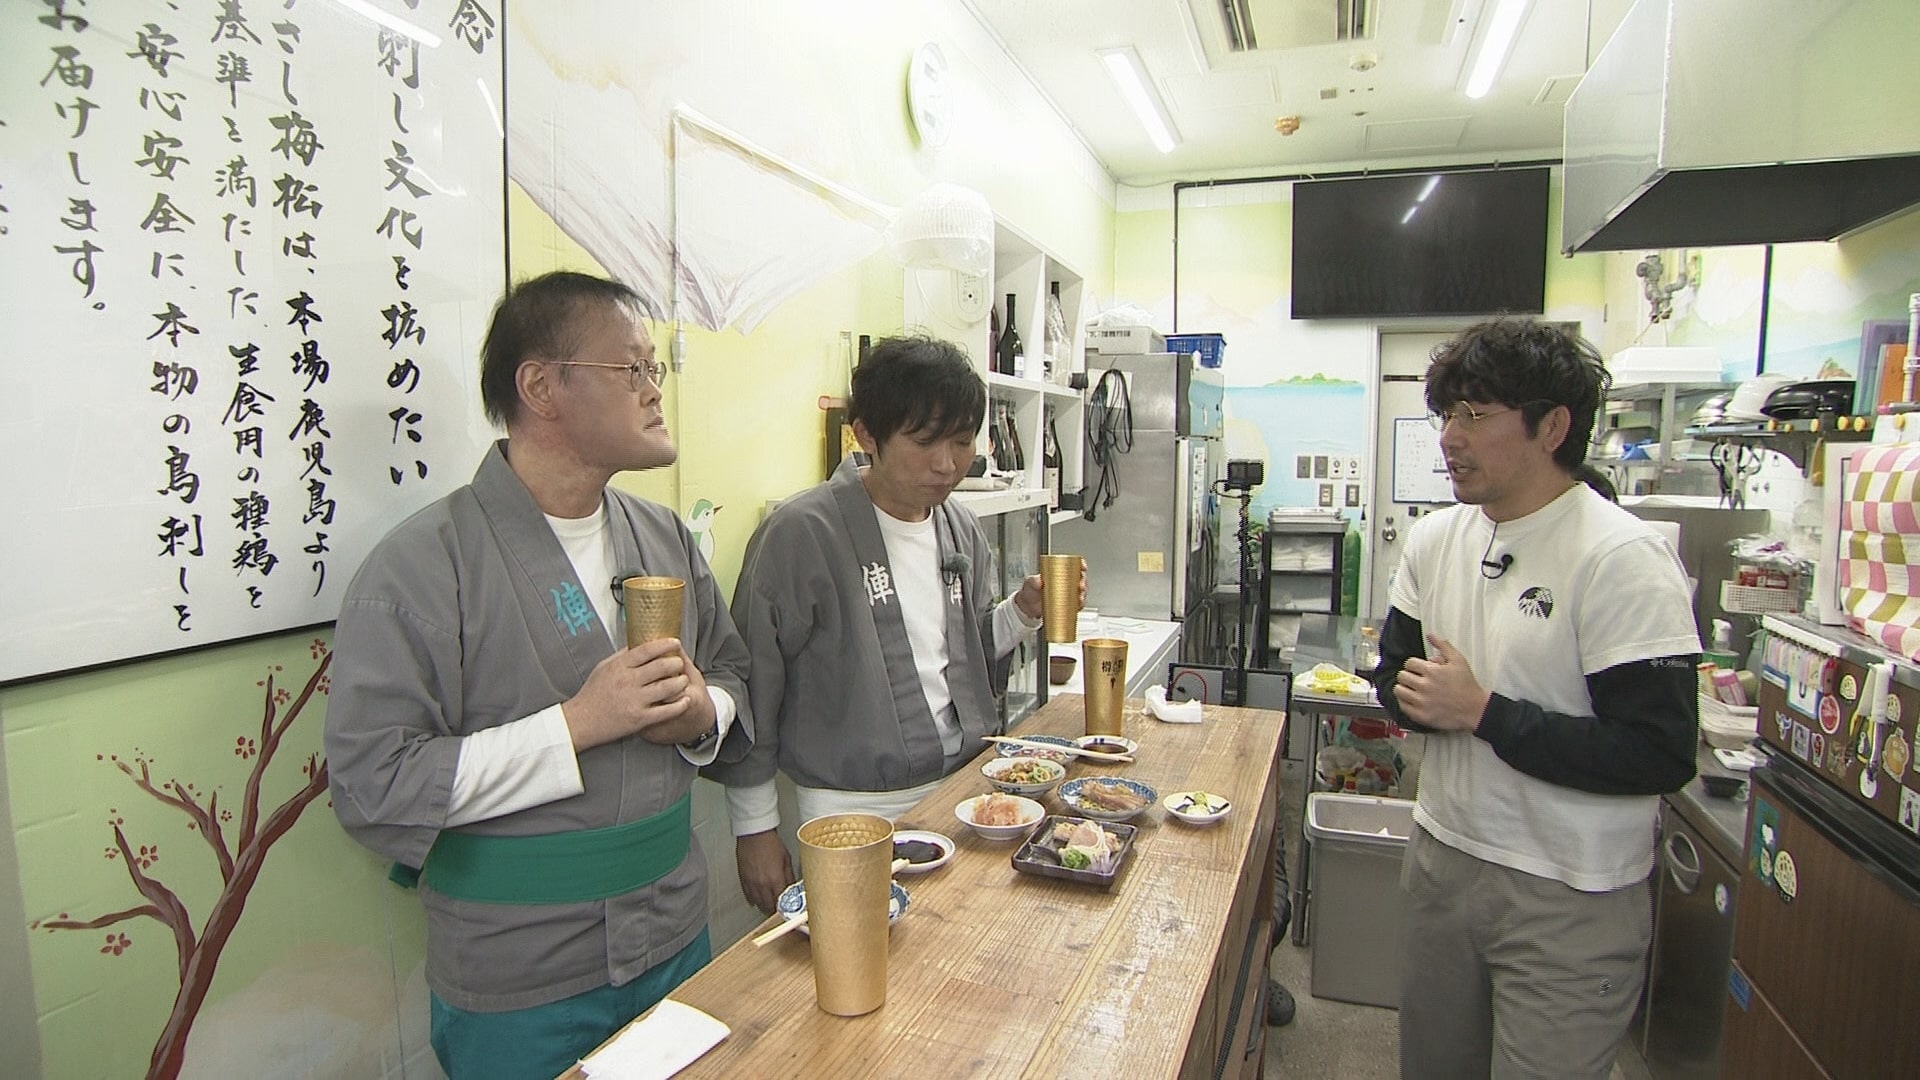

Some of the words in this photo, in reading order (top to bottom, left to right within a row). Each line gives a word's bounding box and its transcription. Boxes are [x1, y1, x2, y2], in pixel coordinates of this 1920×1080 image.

[268, 0, 336, 598] さし梅松は、本場鹿児島より
[376, 0, 432, 486] 刺し文化を拡めたい
[861, 562, 894, 607] 俥
